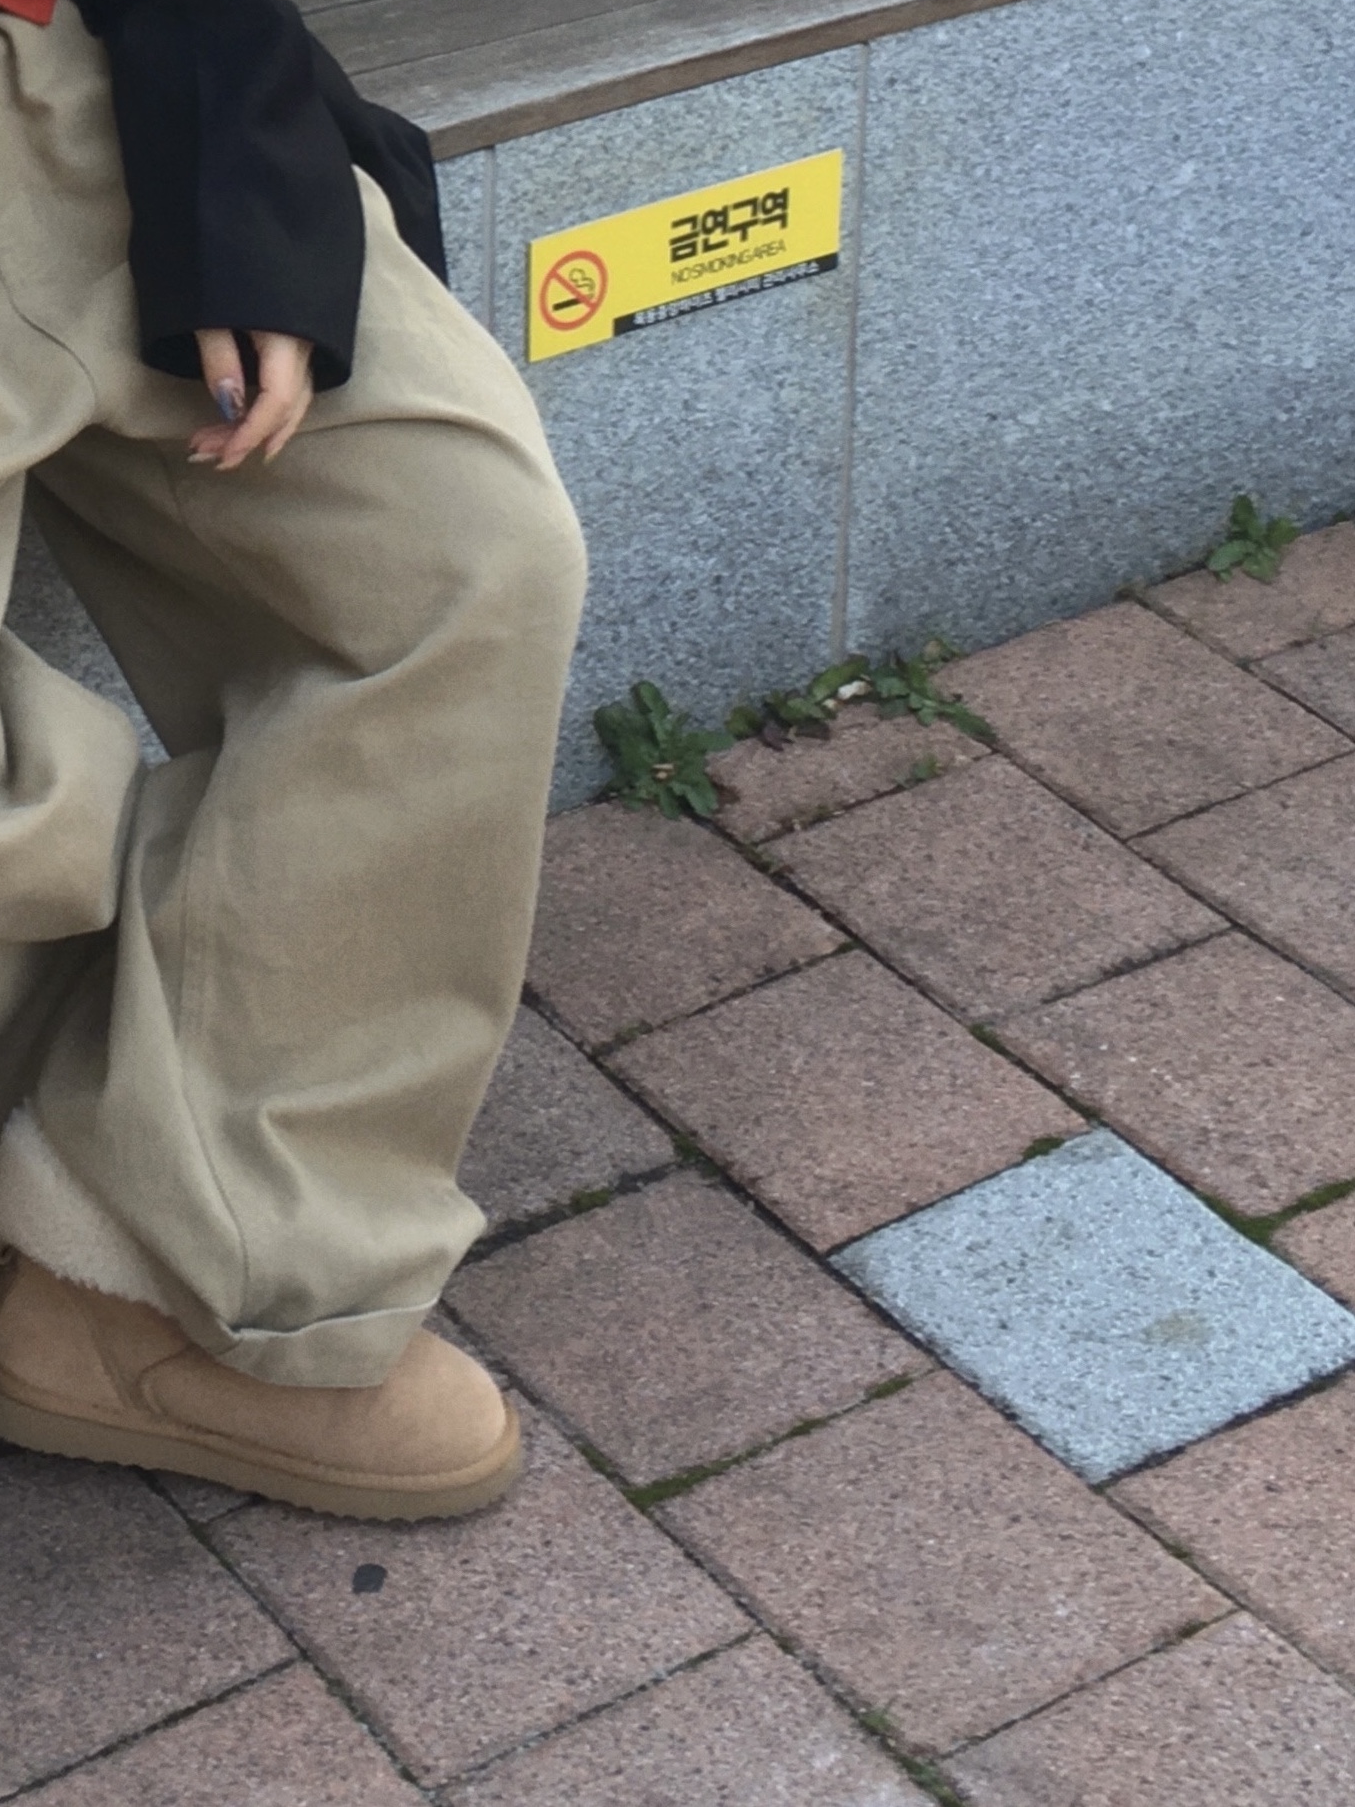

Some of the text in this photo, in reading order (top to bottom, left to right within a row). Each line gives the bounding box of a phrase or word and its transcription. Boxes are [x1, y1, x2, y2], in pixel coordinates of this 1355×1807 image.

[669, 187, 789, 263] 금연구역
[671, 267, 689, 285] NO
[689, 249, 753, 280] SMOKING
[753, 239, 786, 259] AREA
